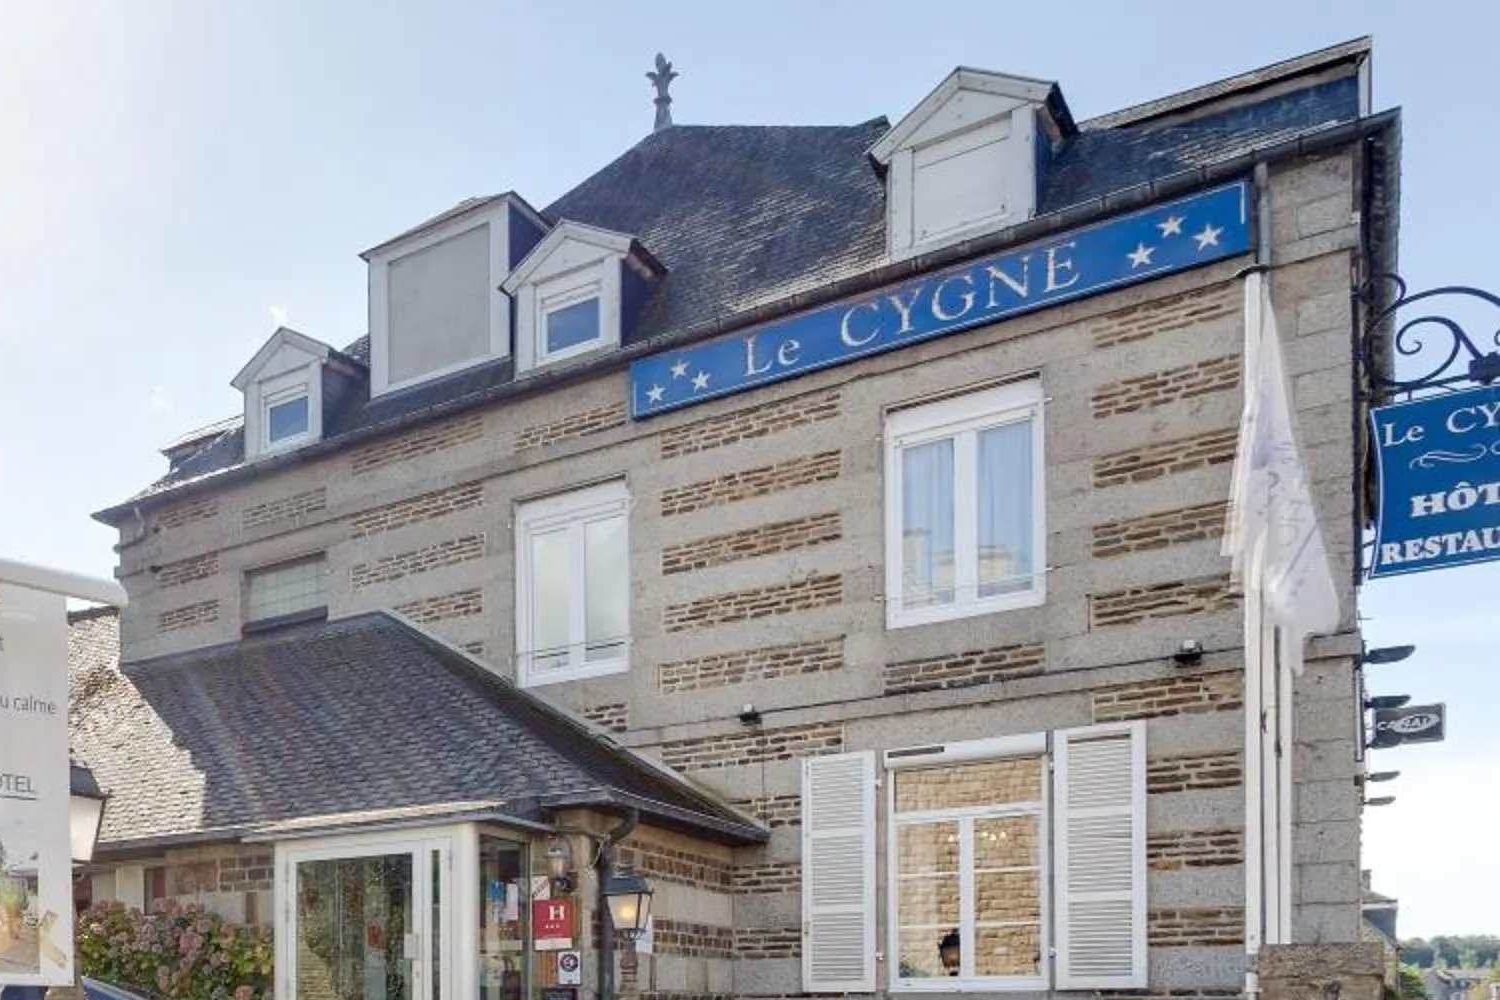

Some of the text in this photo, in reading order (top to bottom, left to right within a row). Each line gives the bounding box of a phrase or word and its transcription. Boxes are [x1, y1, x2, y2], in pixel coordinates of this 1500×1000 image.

[742, 241, 1083, 377] Le CYGNE
[1382, 401, 1500, 447] Le CY
[13, 694, 58, 715] calme
